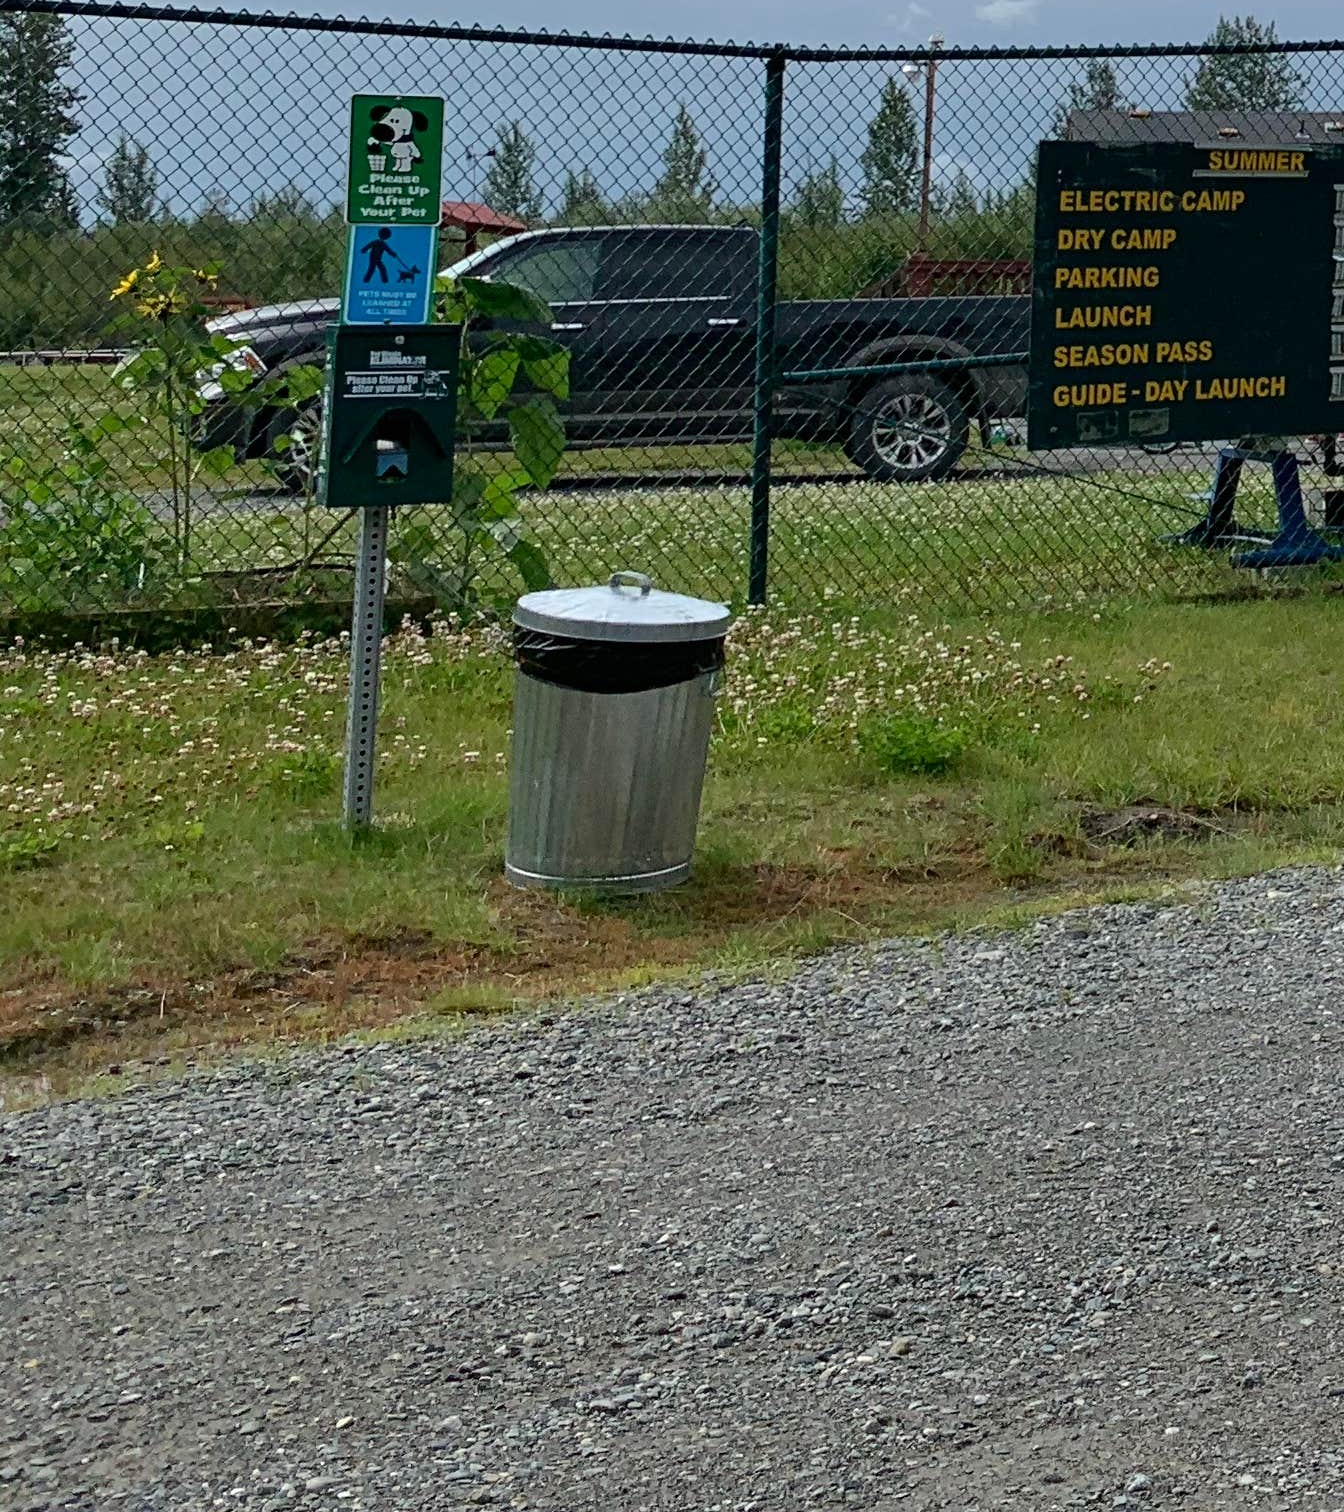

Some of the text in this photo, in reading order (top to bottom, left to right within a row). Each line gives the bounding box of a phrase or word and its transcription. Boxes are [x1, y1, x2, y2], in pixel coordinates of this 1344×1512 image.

[1208, 150, 1305, 172] SUMMER
[370, 173, 420, 184] Please
[358, 184, 430, 197] Clean Up
[373, 195, 415, 206] After
[1059, 190, 1245, 213] ELECTRIC CAMP
[360, 207, 427, 218] Your Pet
[1057, 228, 1177, 251] DRY CAMP
[1055, 266, 1160, 289] PARKING
[358, 290, 379, 298] PETS
[1055, 305, 1152, 329] LAUNCH
[1053, 340, 1214, 368] SEASON PASS
[346, 375, 378, 385] Please
[379, 375, 405, 384] Clean
[351, 384, 374, 394] after
[375, 385, 396, 394] your
[1053, 383, 1127, 408] GUIDE
[1145, 380, 1190, 402] DAY
[1194, 376, 1286, 400] LAUNCH
